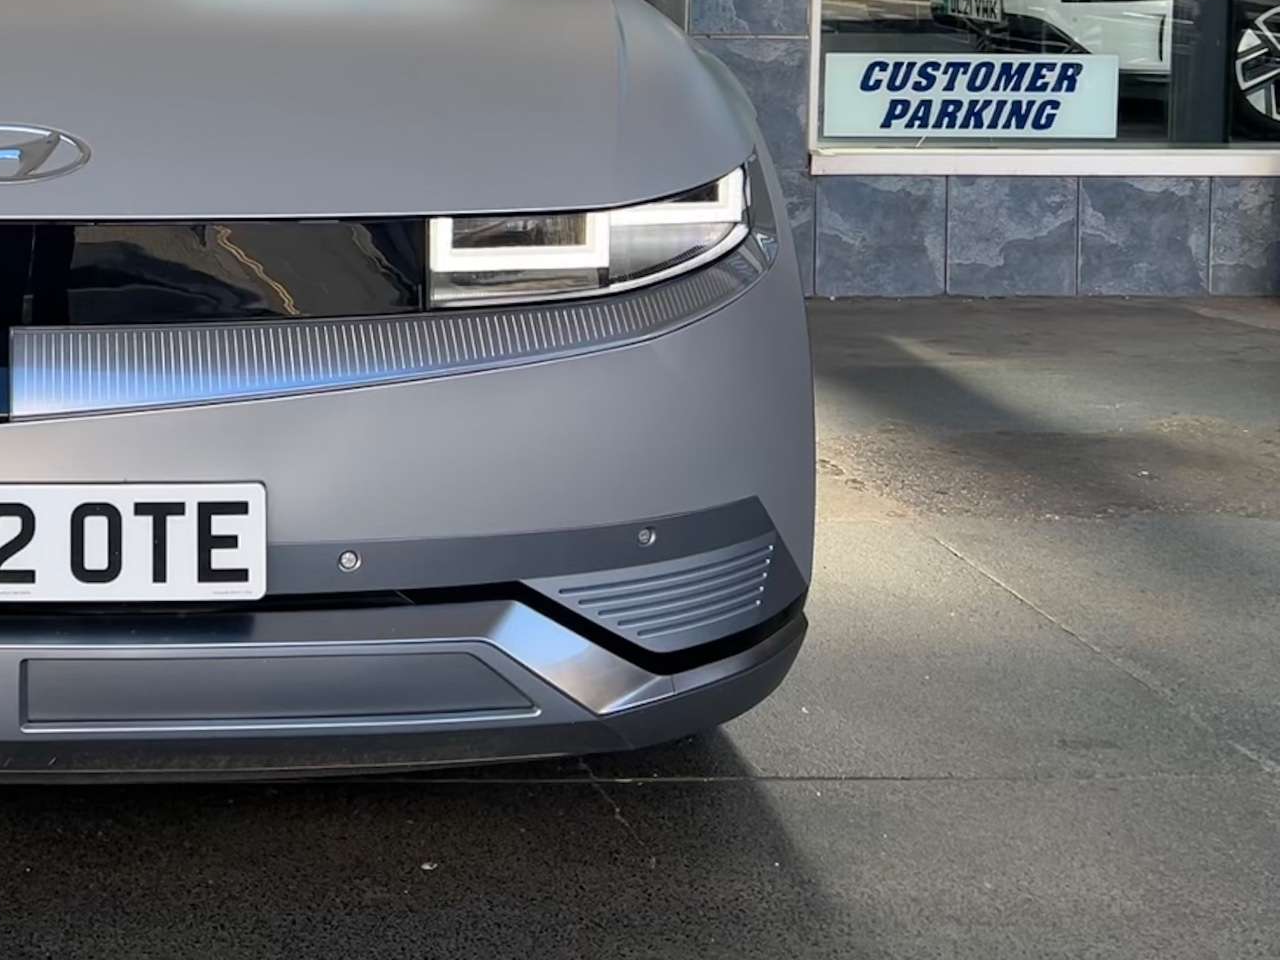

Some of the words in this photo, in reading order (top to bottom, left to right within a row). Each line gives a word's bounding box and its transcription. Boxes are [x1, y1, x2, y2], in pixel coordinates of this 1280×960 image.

[859, 61, 1084, 92] CUSTOMER
[880, 99, 1062, 130] PARKING
[70, 501, 250, 583] OTE
